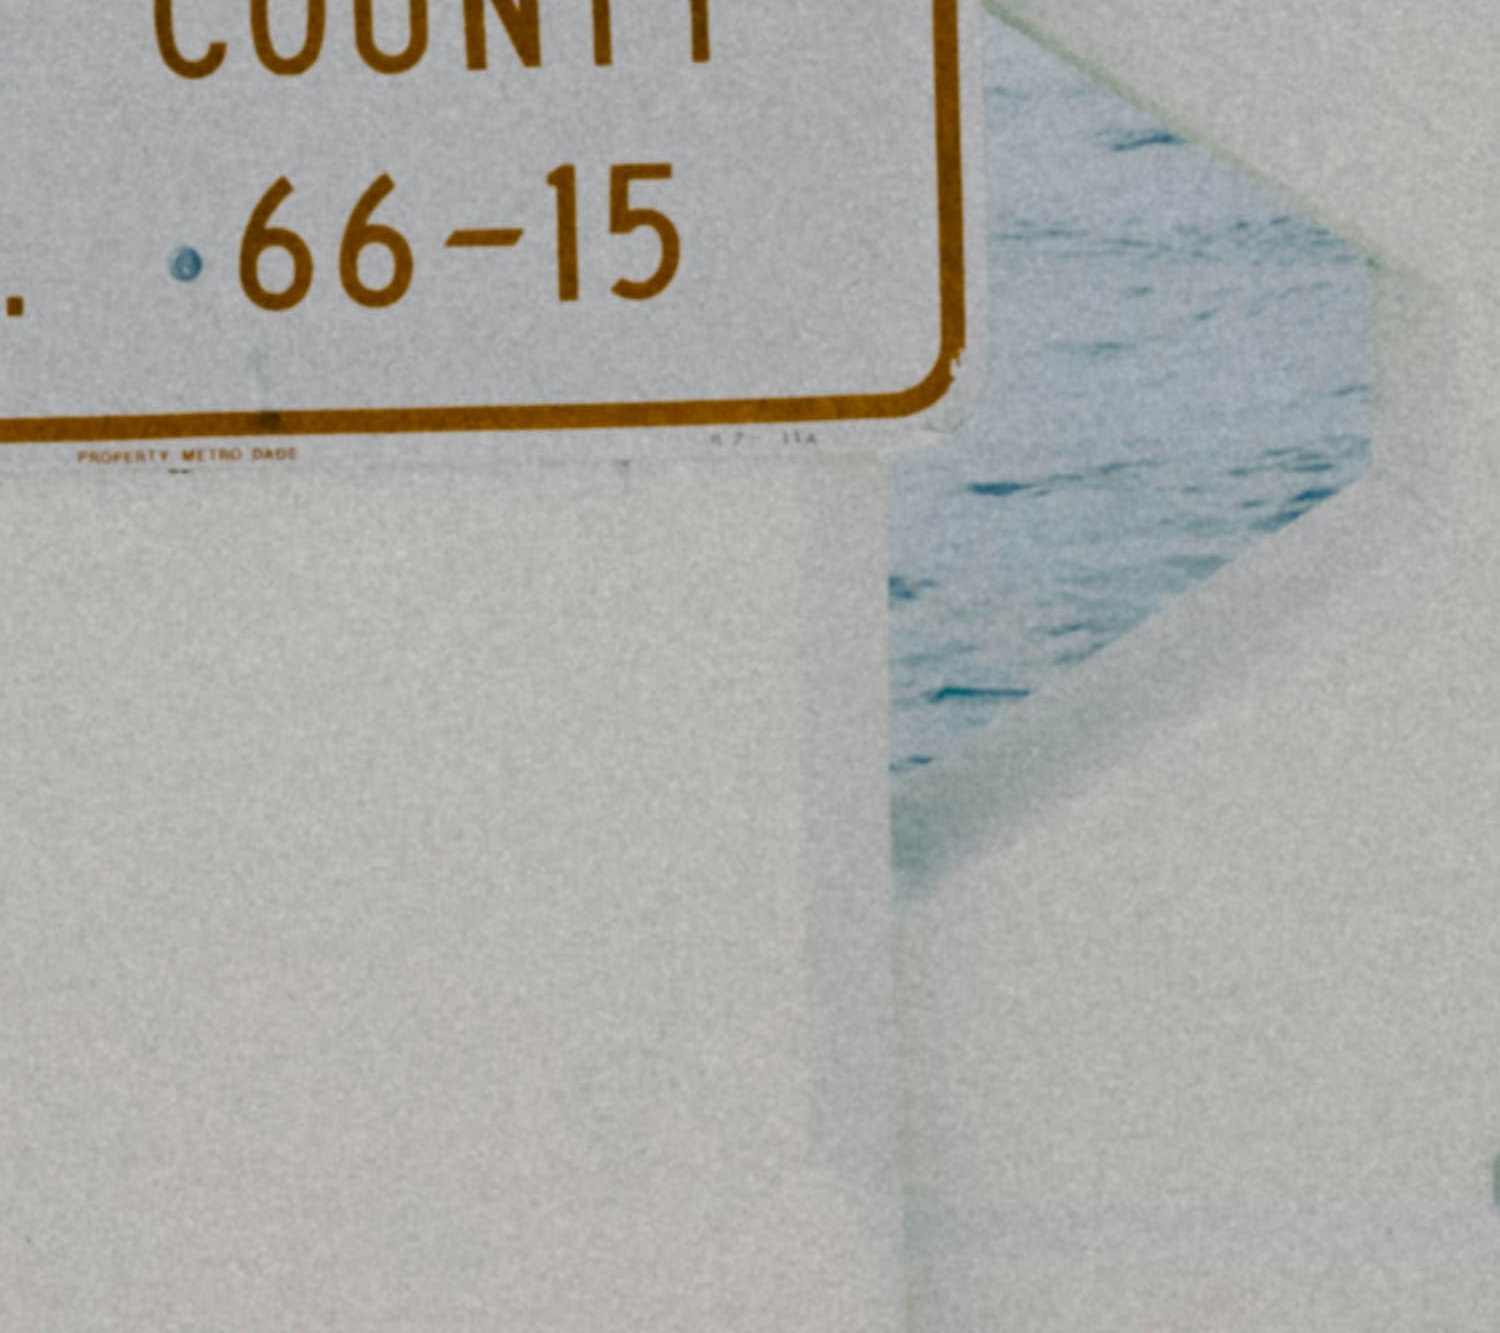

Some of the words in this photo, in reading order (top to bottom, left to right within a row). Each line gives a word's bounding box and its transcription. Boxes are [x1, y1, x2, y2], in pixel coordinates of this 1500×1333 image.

[238, 162, 681, 312] 66-15
[76, 448, 169, 465] PROPERTY
[180, 447, 243, 463] METRO
[251, 446, 297, 462] DADE
